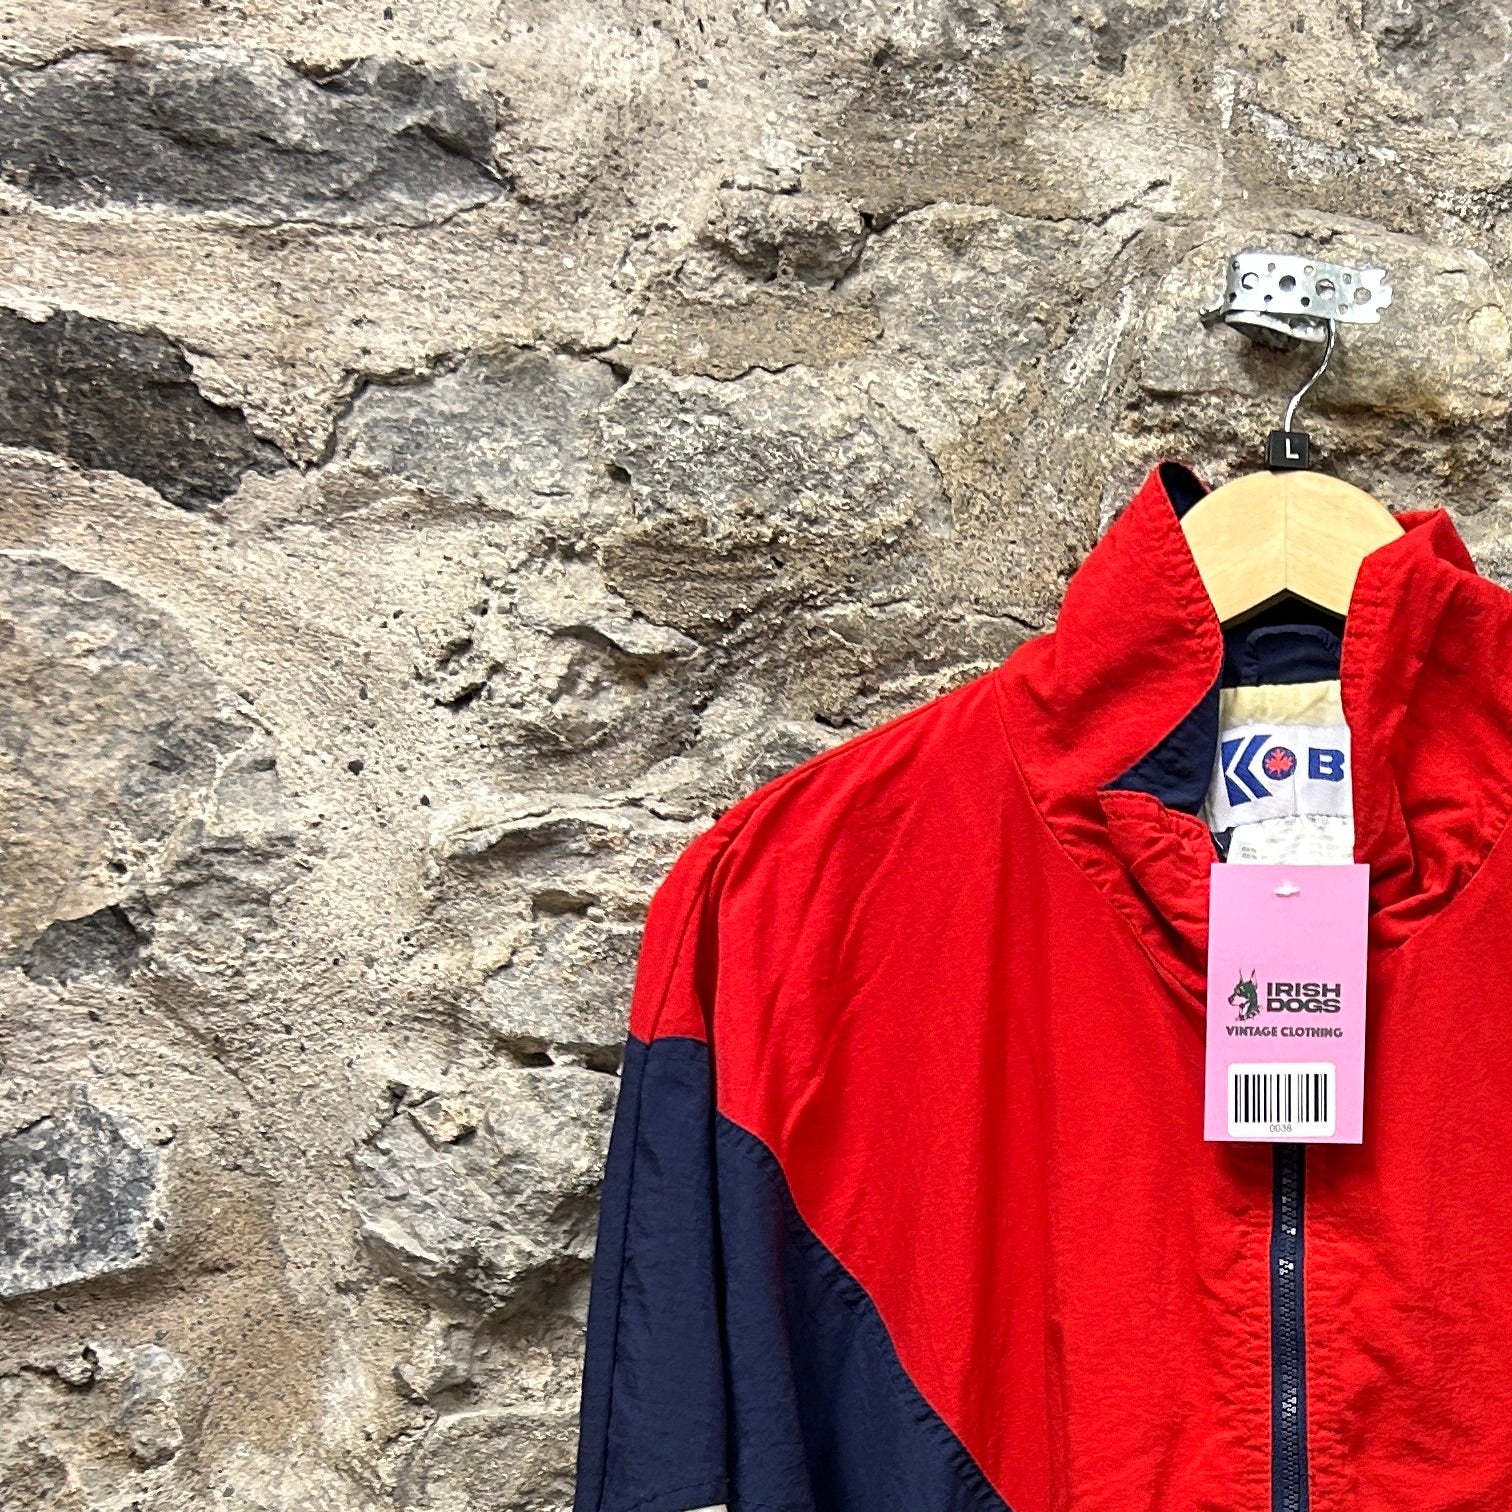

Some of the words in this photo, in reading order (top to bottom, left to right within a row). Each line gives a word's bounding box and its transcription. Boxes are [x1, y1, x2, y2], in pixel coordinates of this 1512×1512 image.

[1285, 438, 1299, 458] L
[1267, 982, 1341, 997] IRISH
[1267, 998, 1341, 1013] DOGS
[1226, 1025, 1278, 1038] VINTAGE
[1281, 1026, 1344, 1039] CLOTHING
